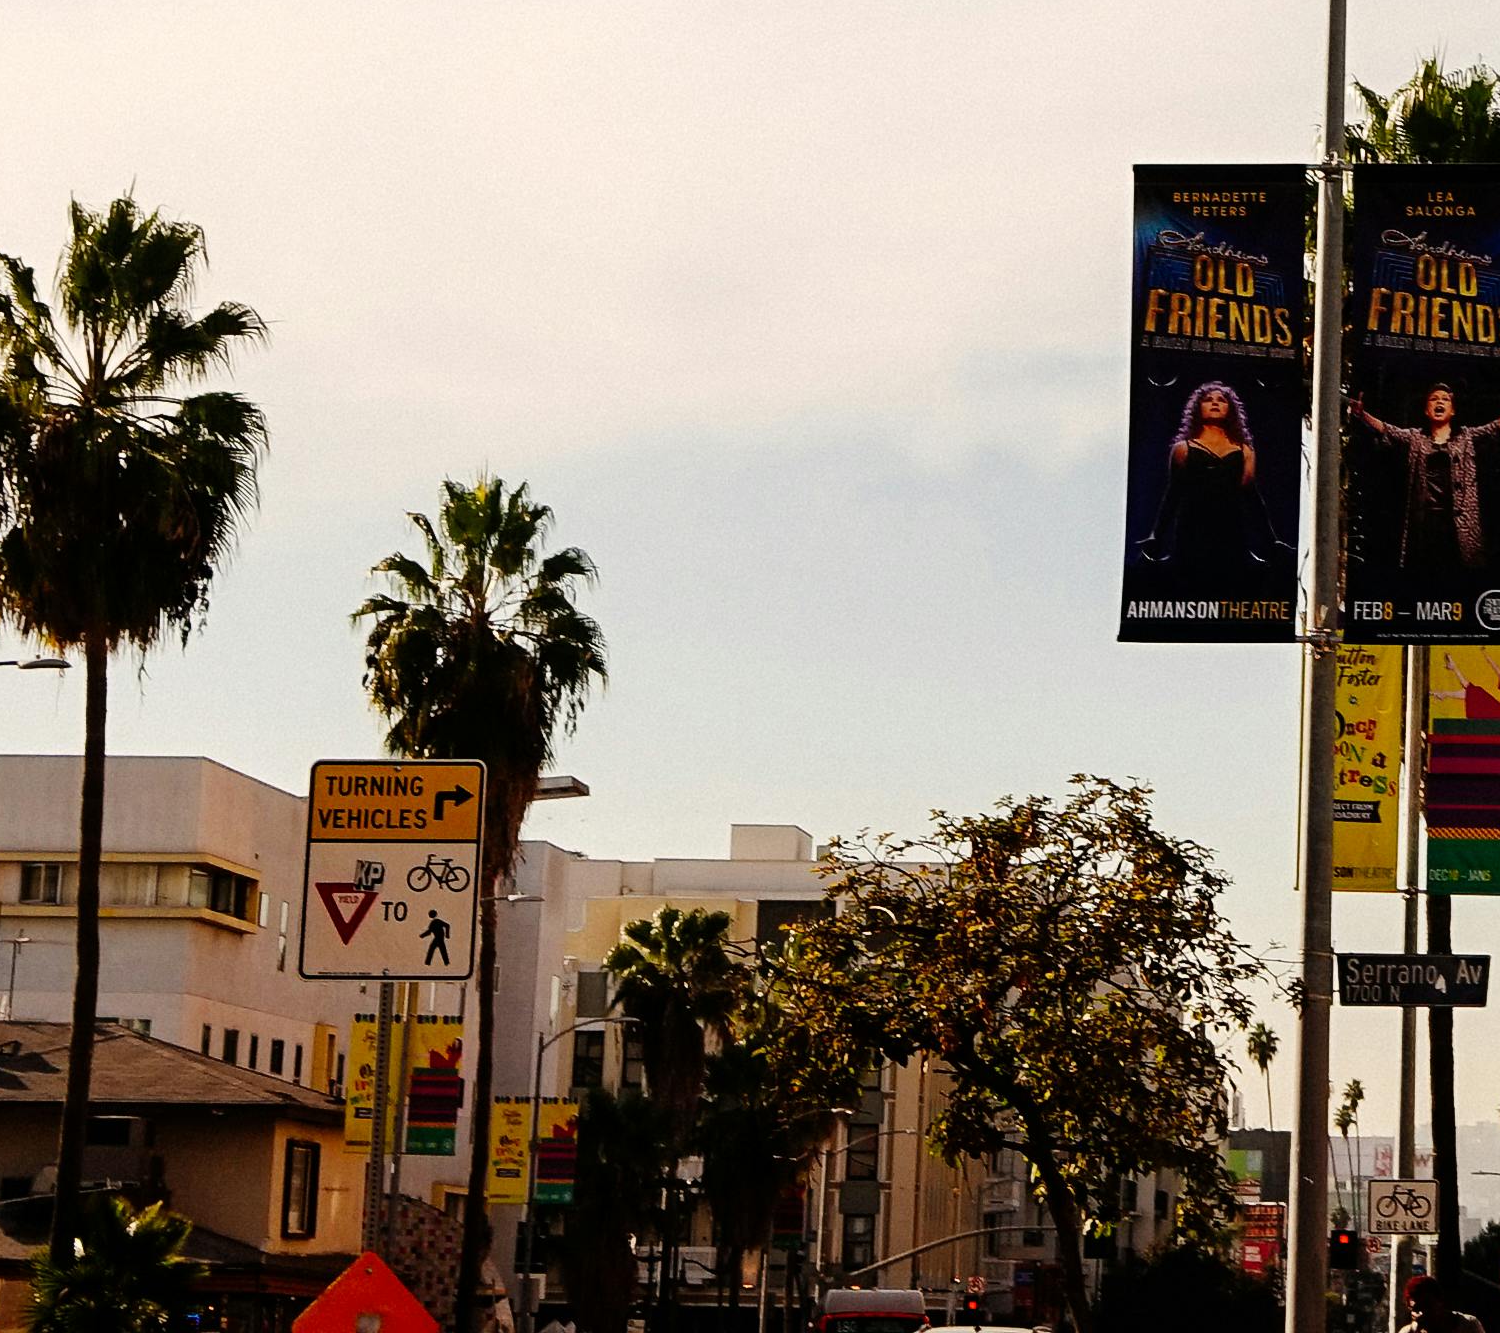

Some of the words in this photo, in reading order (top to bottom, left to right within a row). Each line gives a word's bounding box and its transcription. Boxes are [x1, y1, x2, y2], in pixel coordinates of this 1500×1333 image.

[1172, 191, 1267, 204] BERNADETTE
[1426, 191, 1455, 204] LEA
[1192, 206, 1247, 218] PETERS
[1404, 205, 1477, 218] SALONGA
[1192, 253, 1256, 299] OLD
[1414, 252, 1479, 299] OLD
[1142, 286, 1295, 348] FRIENDS
[1353, 600, 1395, 622] FEB8
[1415, 600, 1463, 622] MAR9
[1337, 666, 1383, 687] Foster
[1371, 751, 1388, 769] a
[326, 775, 424, 797] TURNING
[317, 808, 428, 829] VEHICLES
[338, 894, 360, 905] YIELD
[381, 901, 408, 922] TO
[1345, 958, 1439, 985] Serrano
[1456, 959, 1484, 985] Av
[1345, 984, 1382, 1003] 1700
[1388, 985, 1402, 1003] N
[1375, 1219, 1402, 1231] BIKE
[1404, 1219, 1430, 1232] LANE
